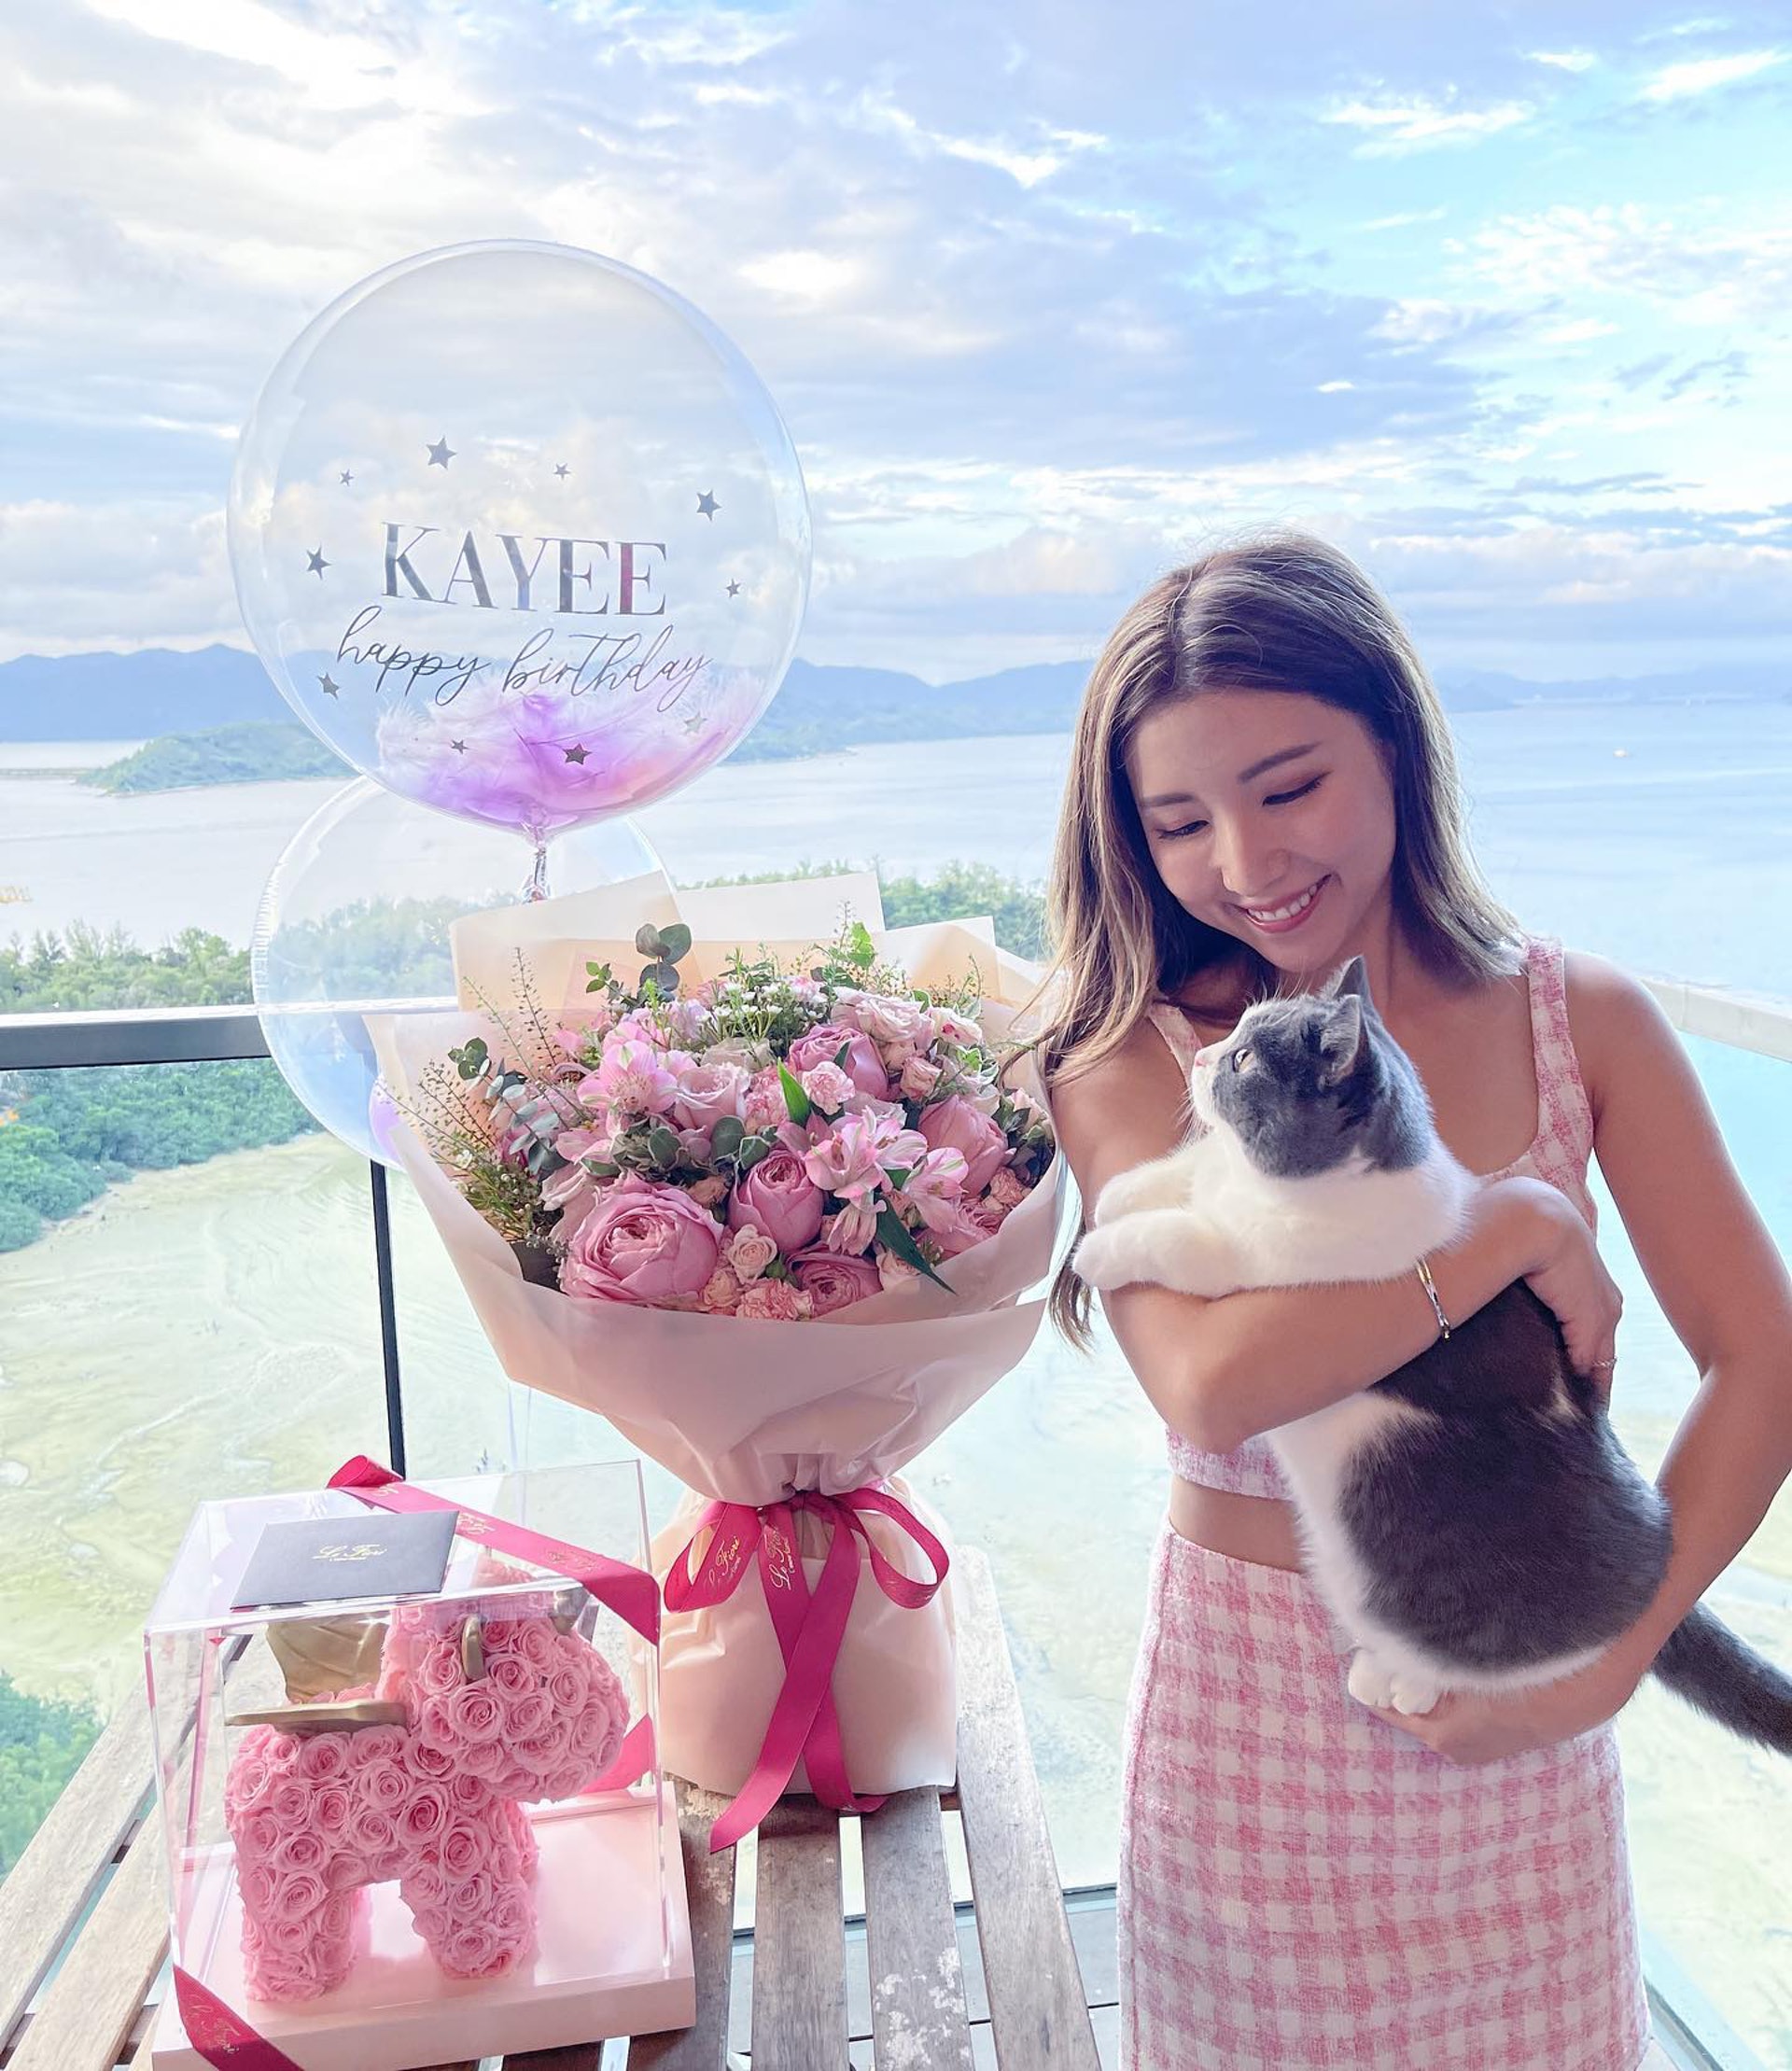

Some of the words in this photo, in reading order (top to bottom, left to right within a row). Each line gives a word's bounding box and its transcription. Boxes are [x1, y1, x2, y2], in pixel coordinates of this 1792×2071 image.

[382, 521, 667, 616] KAYEE
[336, 606, 491, 707] happy
[502, 623, 712, 713] birthday
